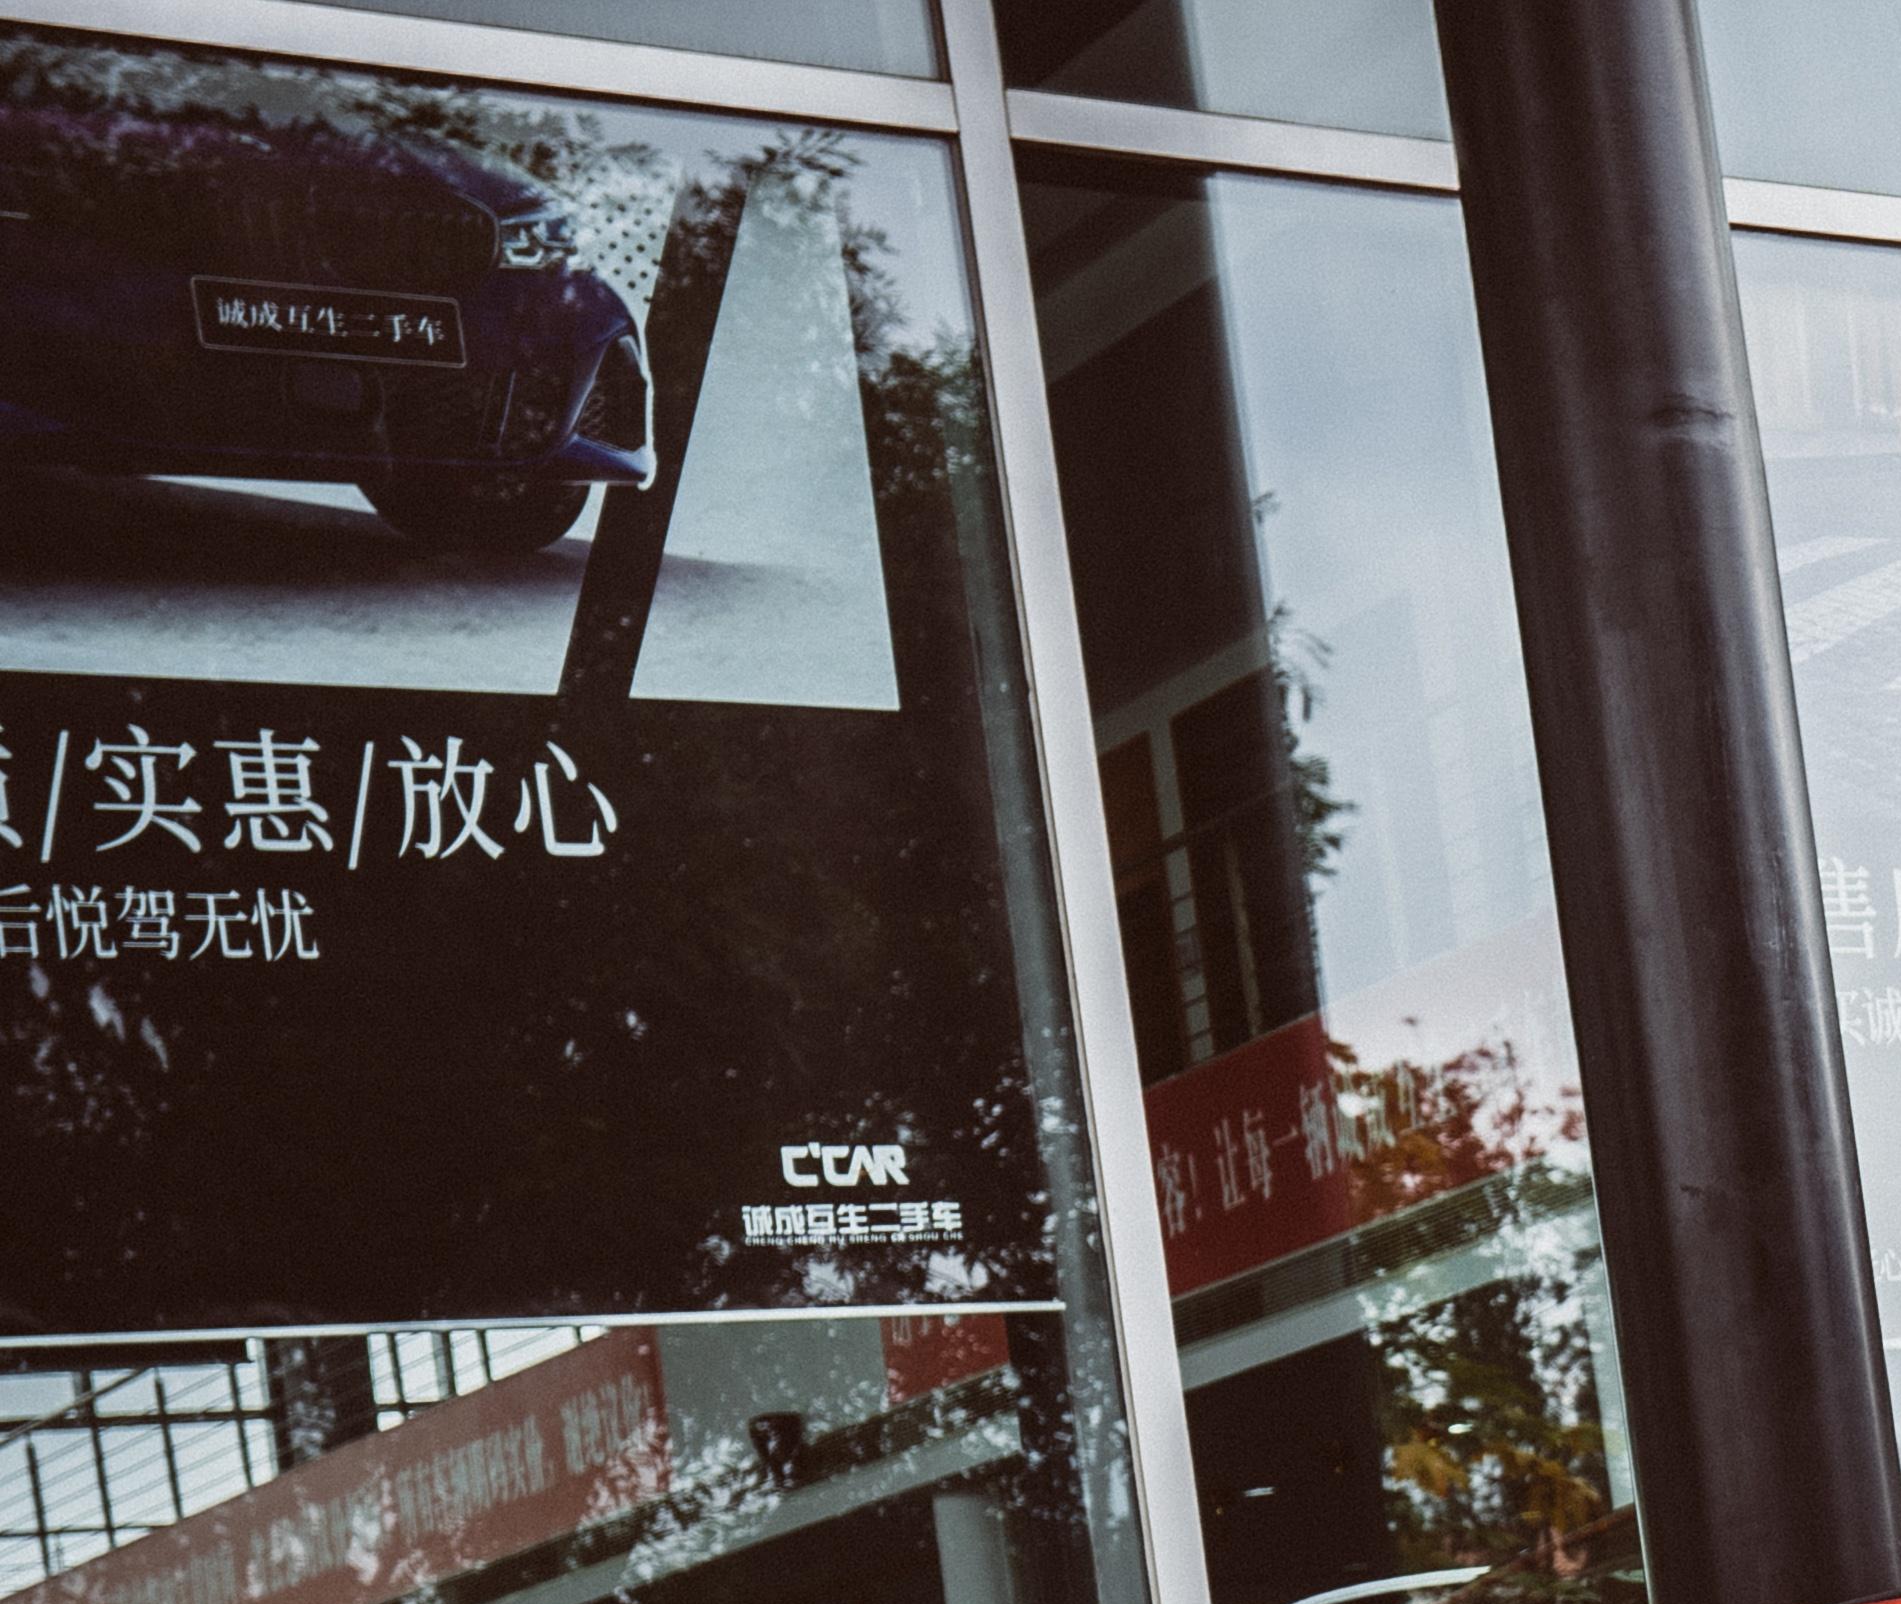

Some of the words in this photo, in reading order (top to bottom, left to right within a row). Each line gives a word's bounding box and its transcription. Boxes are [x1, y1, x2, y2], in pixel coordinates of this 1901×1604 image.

[742, 1201, 962, 1236] 诚成互生二手车
